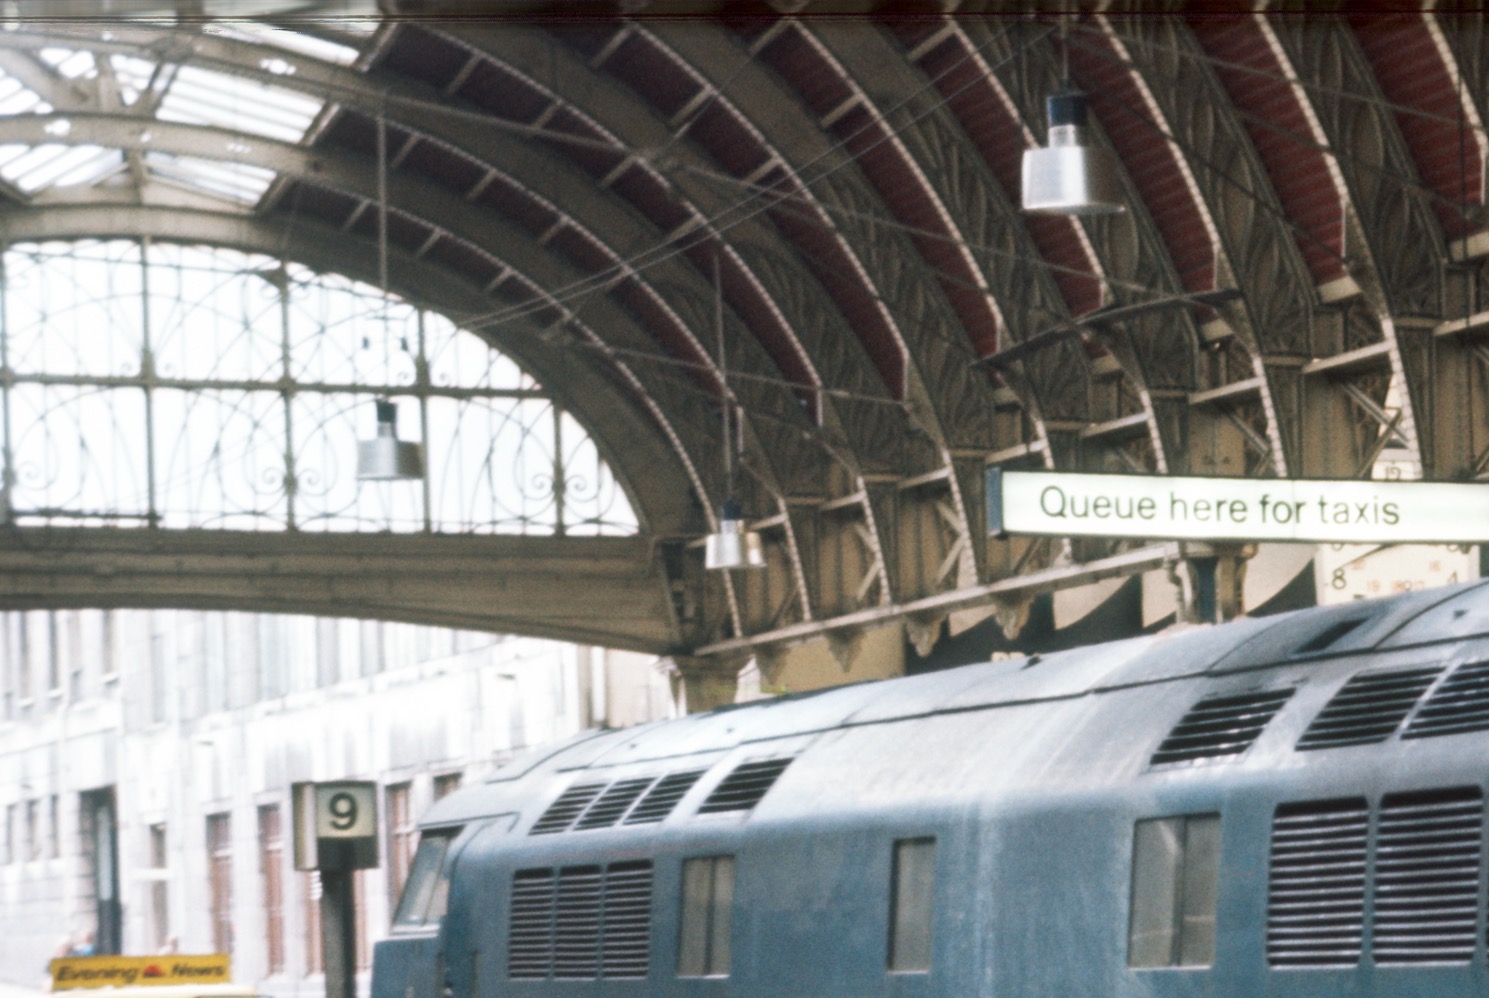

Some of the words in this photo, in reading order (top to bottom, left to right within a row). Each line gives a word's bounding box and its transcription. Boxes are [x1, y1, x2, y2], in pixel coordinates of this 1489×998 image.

[1039, 484, 1157, 521] Queue
[1169, 490, 1248, 524] here
[1259, 493, 1307, 524] for
[1317, 494, 1401, 526] taxis
[1332, 568, 1347, 590] 8
[328, 792, 358, 831] 9
[56, 965, 139, 984] Evening
[172, 963, 225, 977] News
